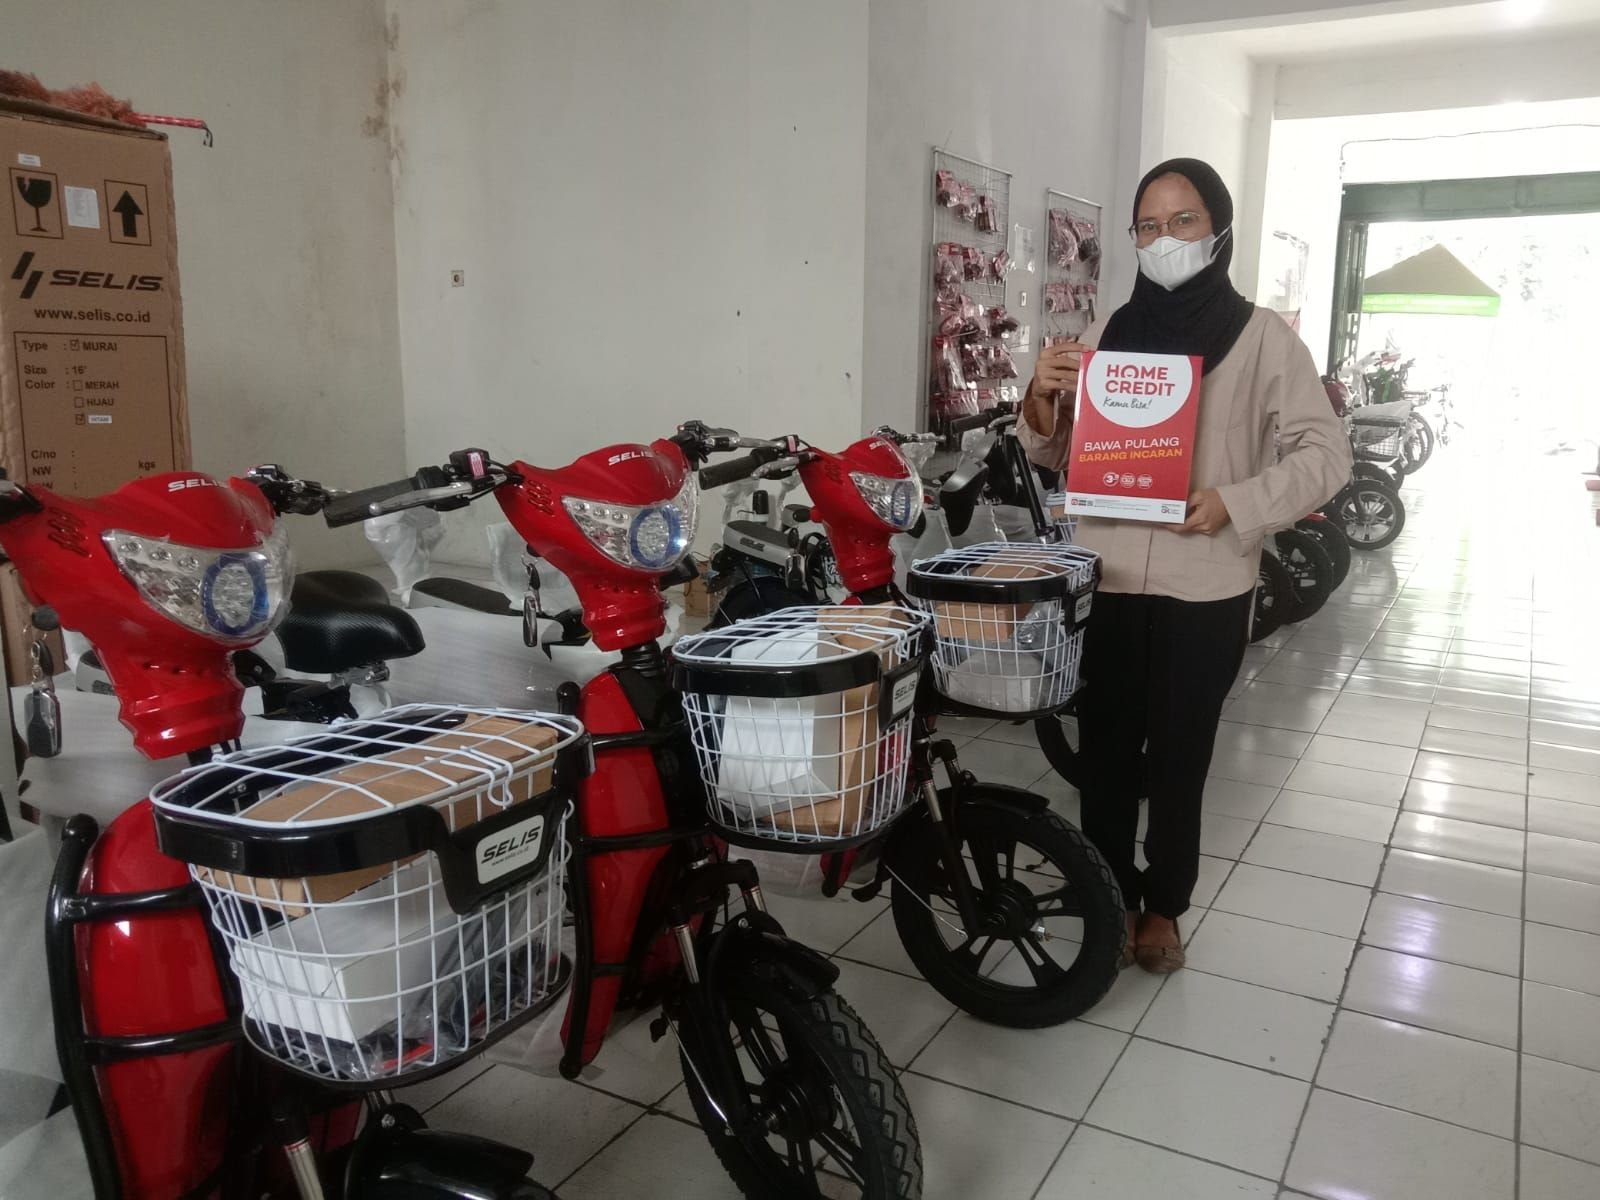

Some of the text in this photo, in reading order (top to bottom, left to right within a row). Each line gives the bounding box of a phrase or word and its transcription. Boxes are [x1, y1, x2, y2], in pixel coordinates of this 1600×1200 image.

[50, 269, 164, 292] SELIS
[34, 308, 150, 323] www.selis.co.id
[21, 340, 48, 352] Type
[82, 341, 118, 351] MURAI
[24, 365, 47, 375] Size
[1106, 364, 1168, 380] HOME
[25, 380, 56, 390] Color
[84, 381, 119, 390] MERAH
[1105, 380, 1175, 396] CREDIT
[86, 397, 114, 407] HIJAU
[1102, 396, 1152, 410] Kamu Bisa!
[1084, 437, 1180, 452] BAWA PULANG
[1079, 448, 1183, 462] BARANG INCARAN
[32, 466, 52, 476] NW
[138, 460, 156, 471] kgs
[481, 826, 541, 864] SELIS
